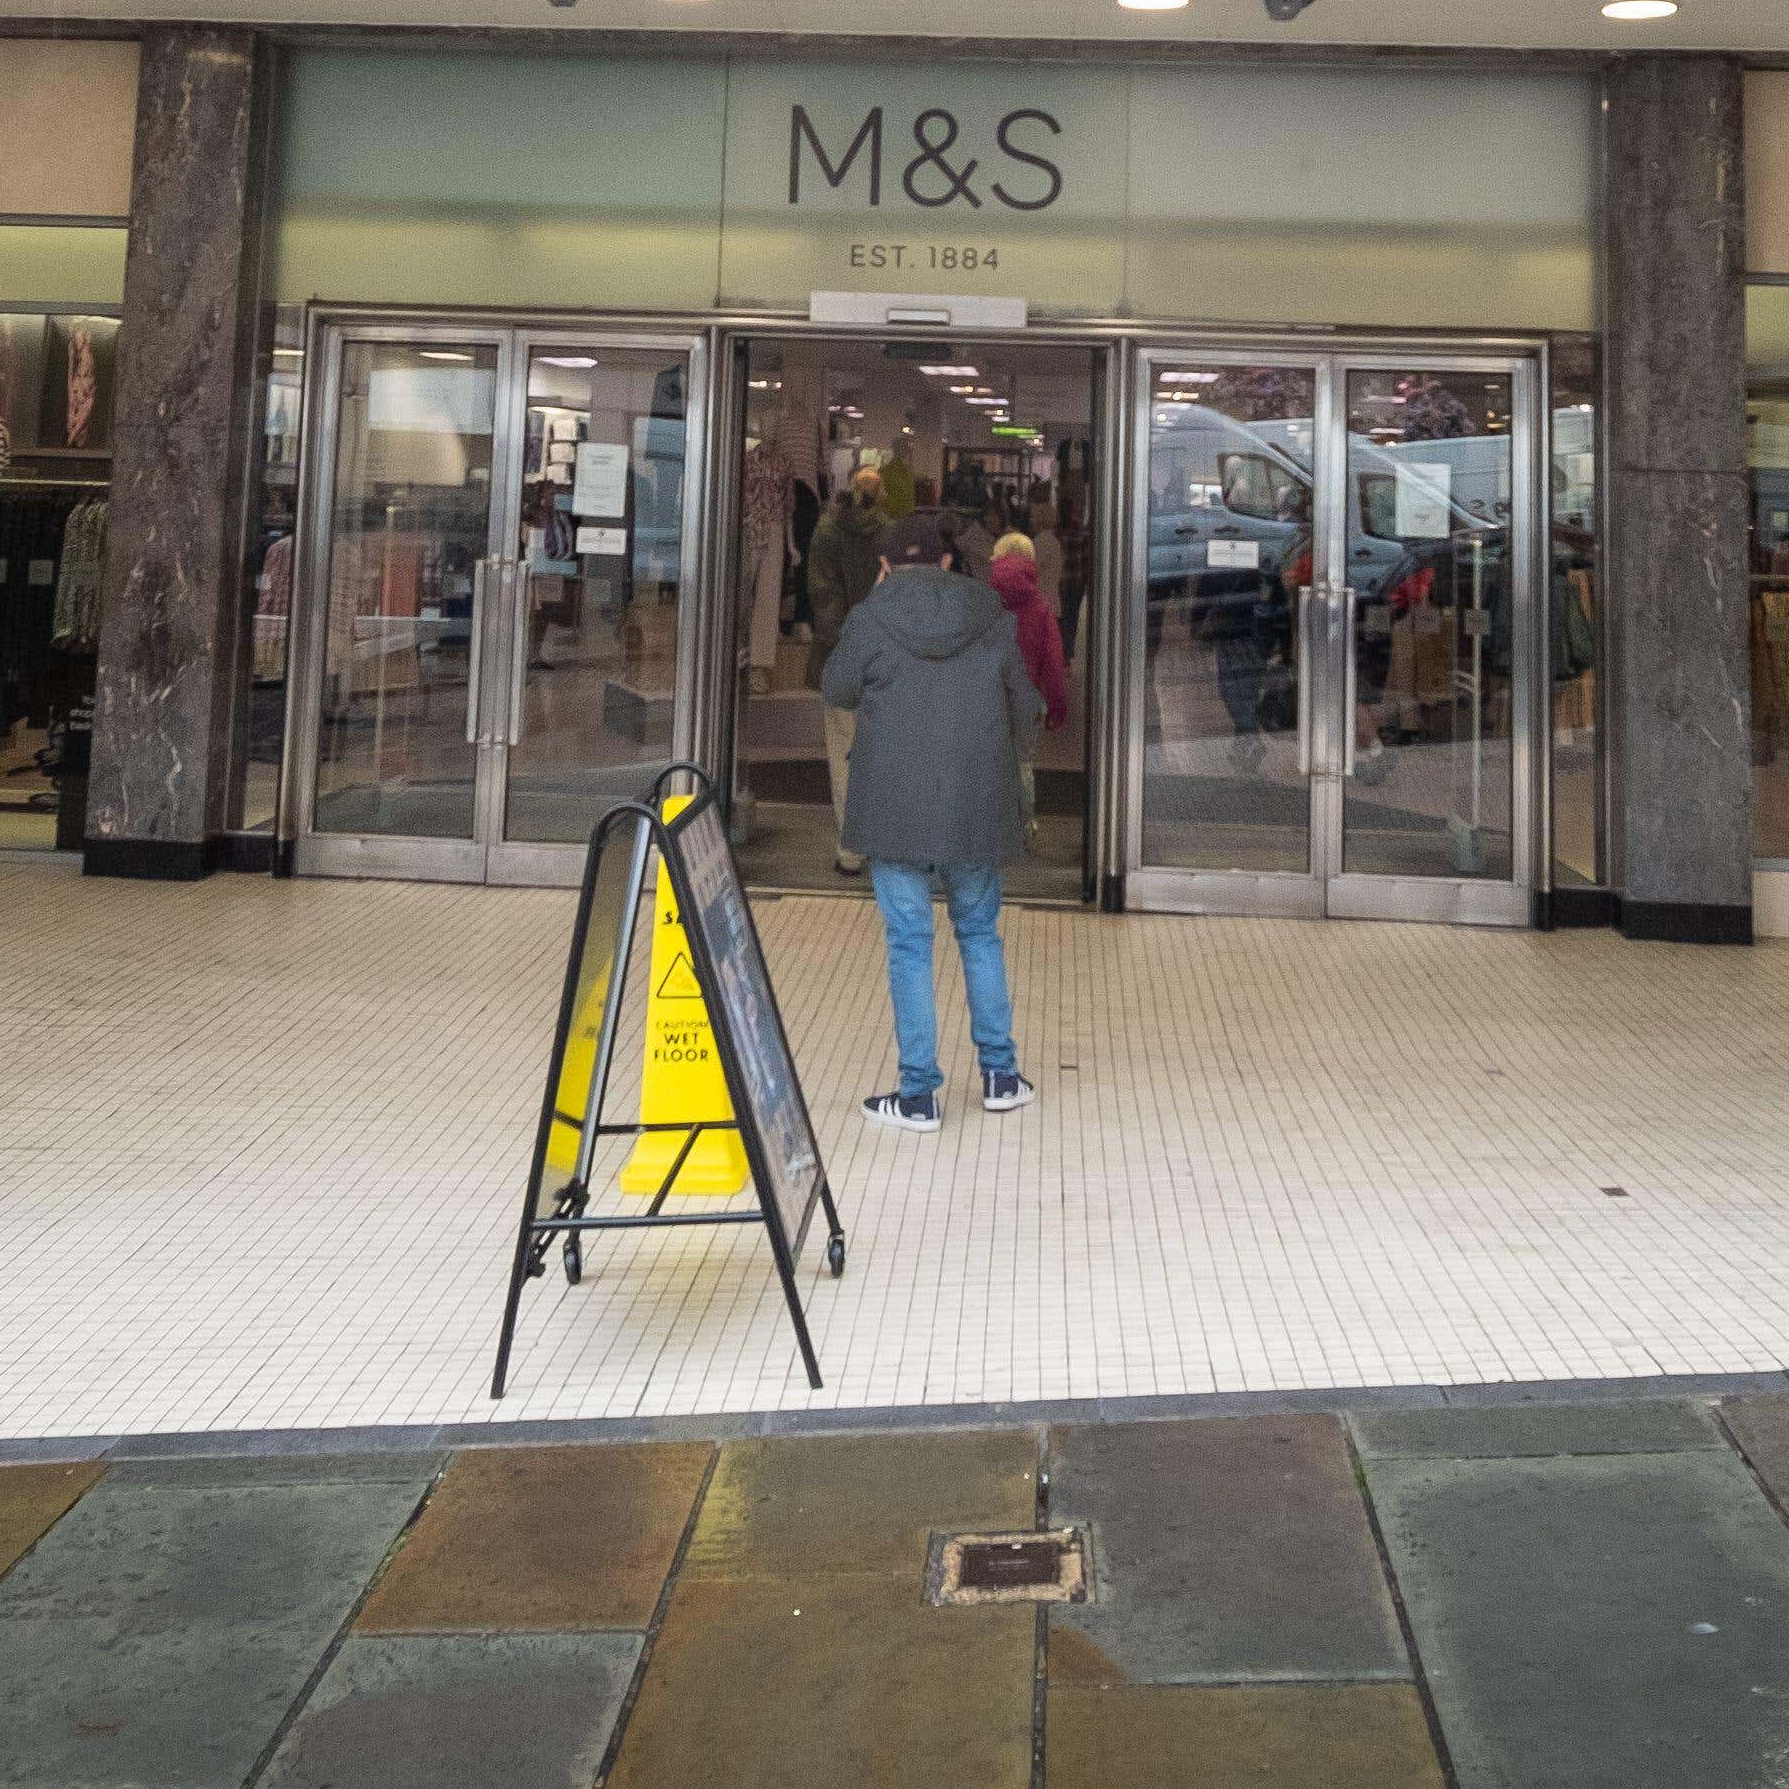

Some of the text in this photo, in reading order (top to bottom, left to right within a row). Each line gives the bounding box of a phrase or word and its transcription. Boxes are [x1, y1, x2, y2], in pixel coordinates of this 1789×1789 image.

[787, 104, 1062, 211] M&S
[849, 244, 999, 271] EST. 1884
[664, 1032, 699, 1046] WET
[654, 1048, 709, 1062] FLOOR
